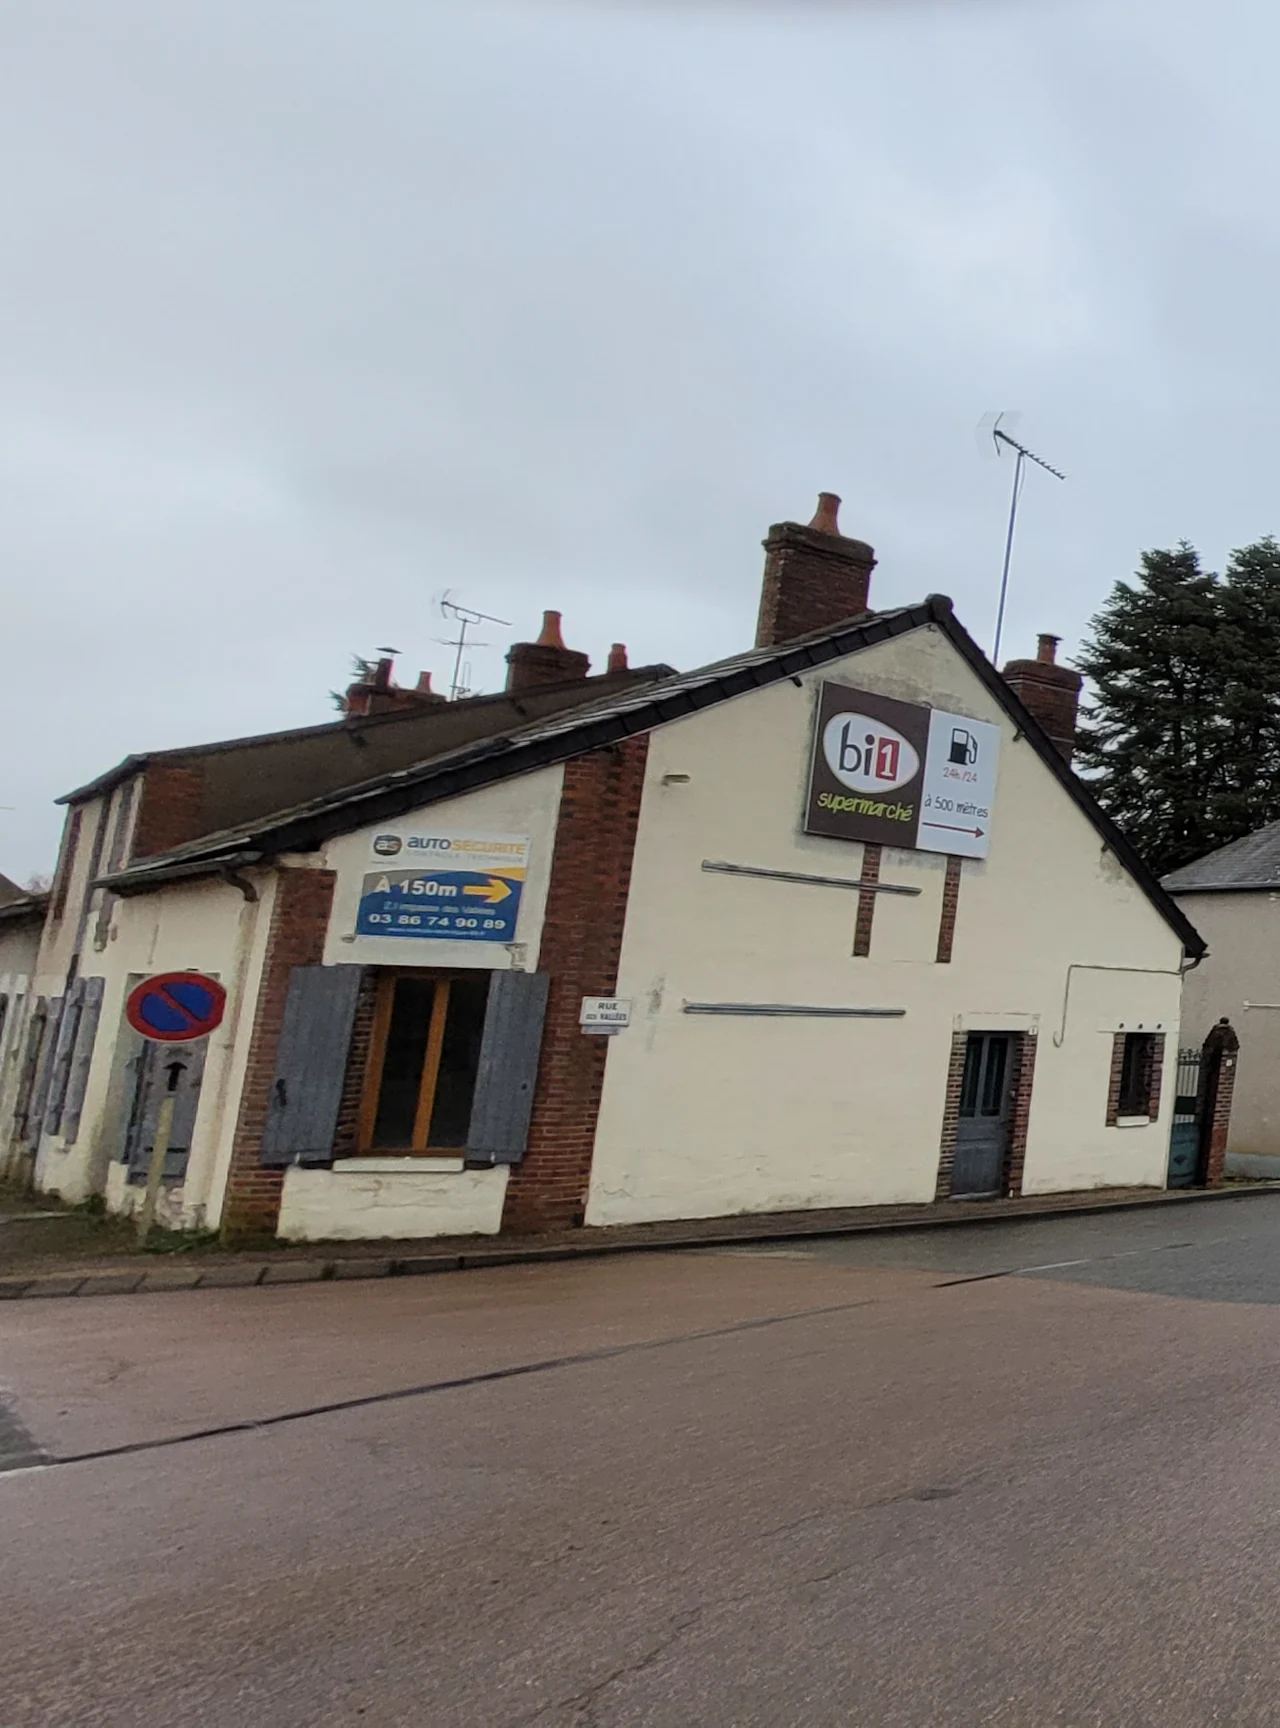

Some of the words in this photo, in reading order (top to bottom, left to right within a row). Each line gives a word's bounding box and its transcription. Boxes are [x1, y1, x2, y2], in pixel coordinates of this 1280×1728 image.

[838, 720, 898, 779] bi1
[816, 792, 914, 822] supermarché
[934, 796, 954, 812] 500
[399, 878, 458, 897] 150m
[368, 913, 393, 924] 03
[397, 914, 422, 925] 86
[427, 916, 450, 926] 74
[454, 917, 479, 928] 90
[483, 919, 506, 929] 89
[597, 1002, 619, 1010] RUE
